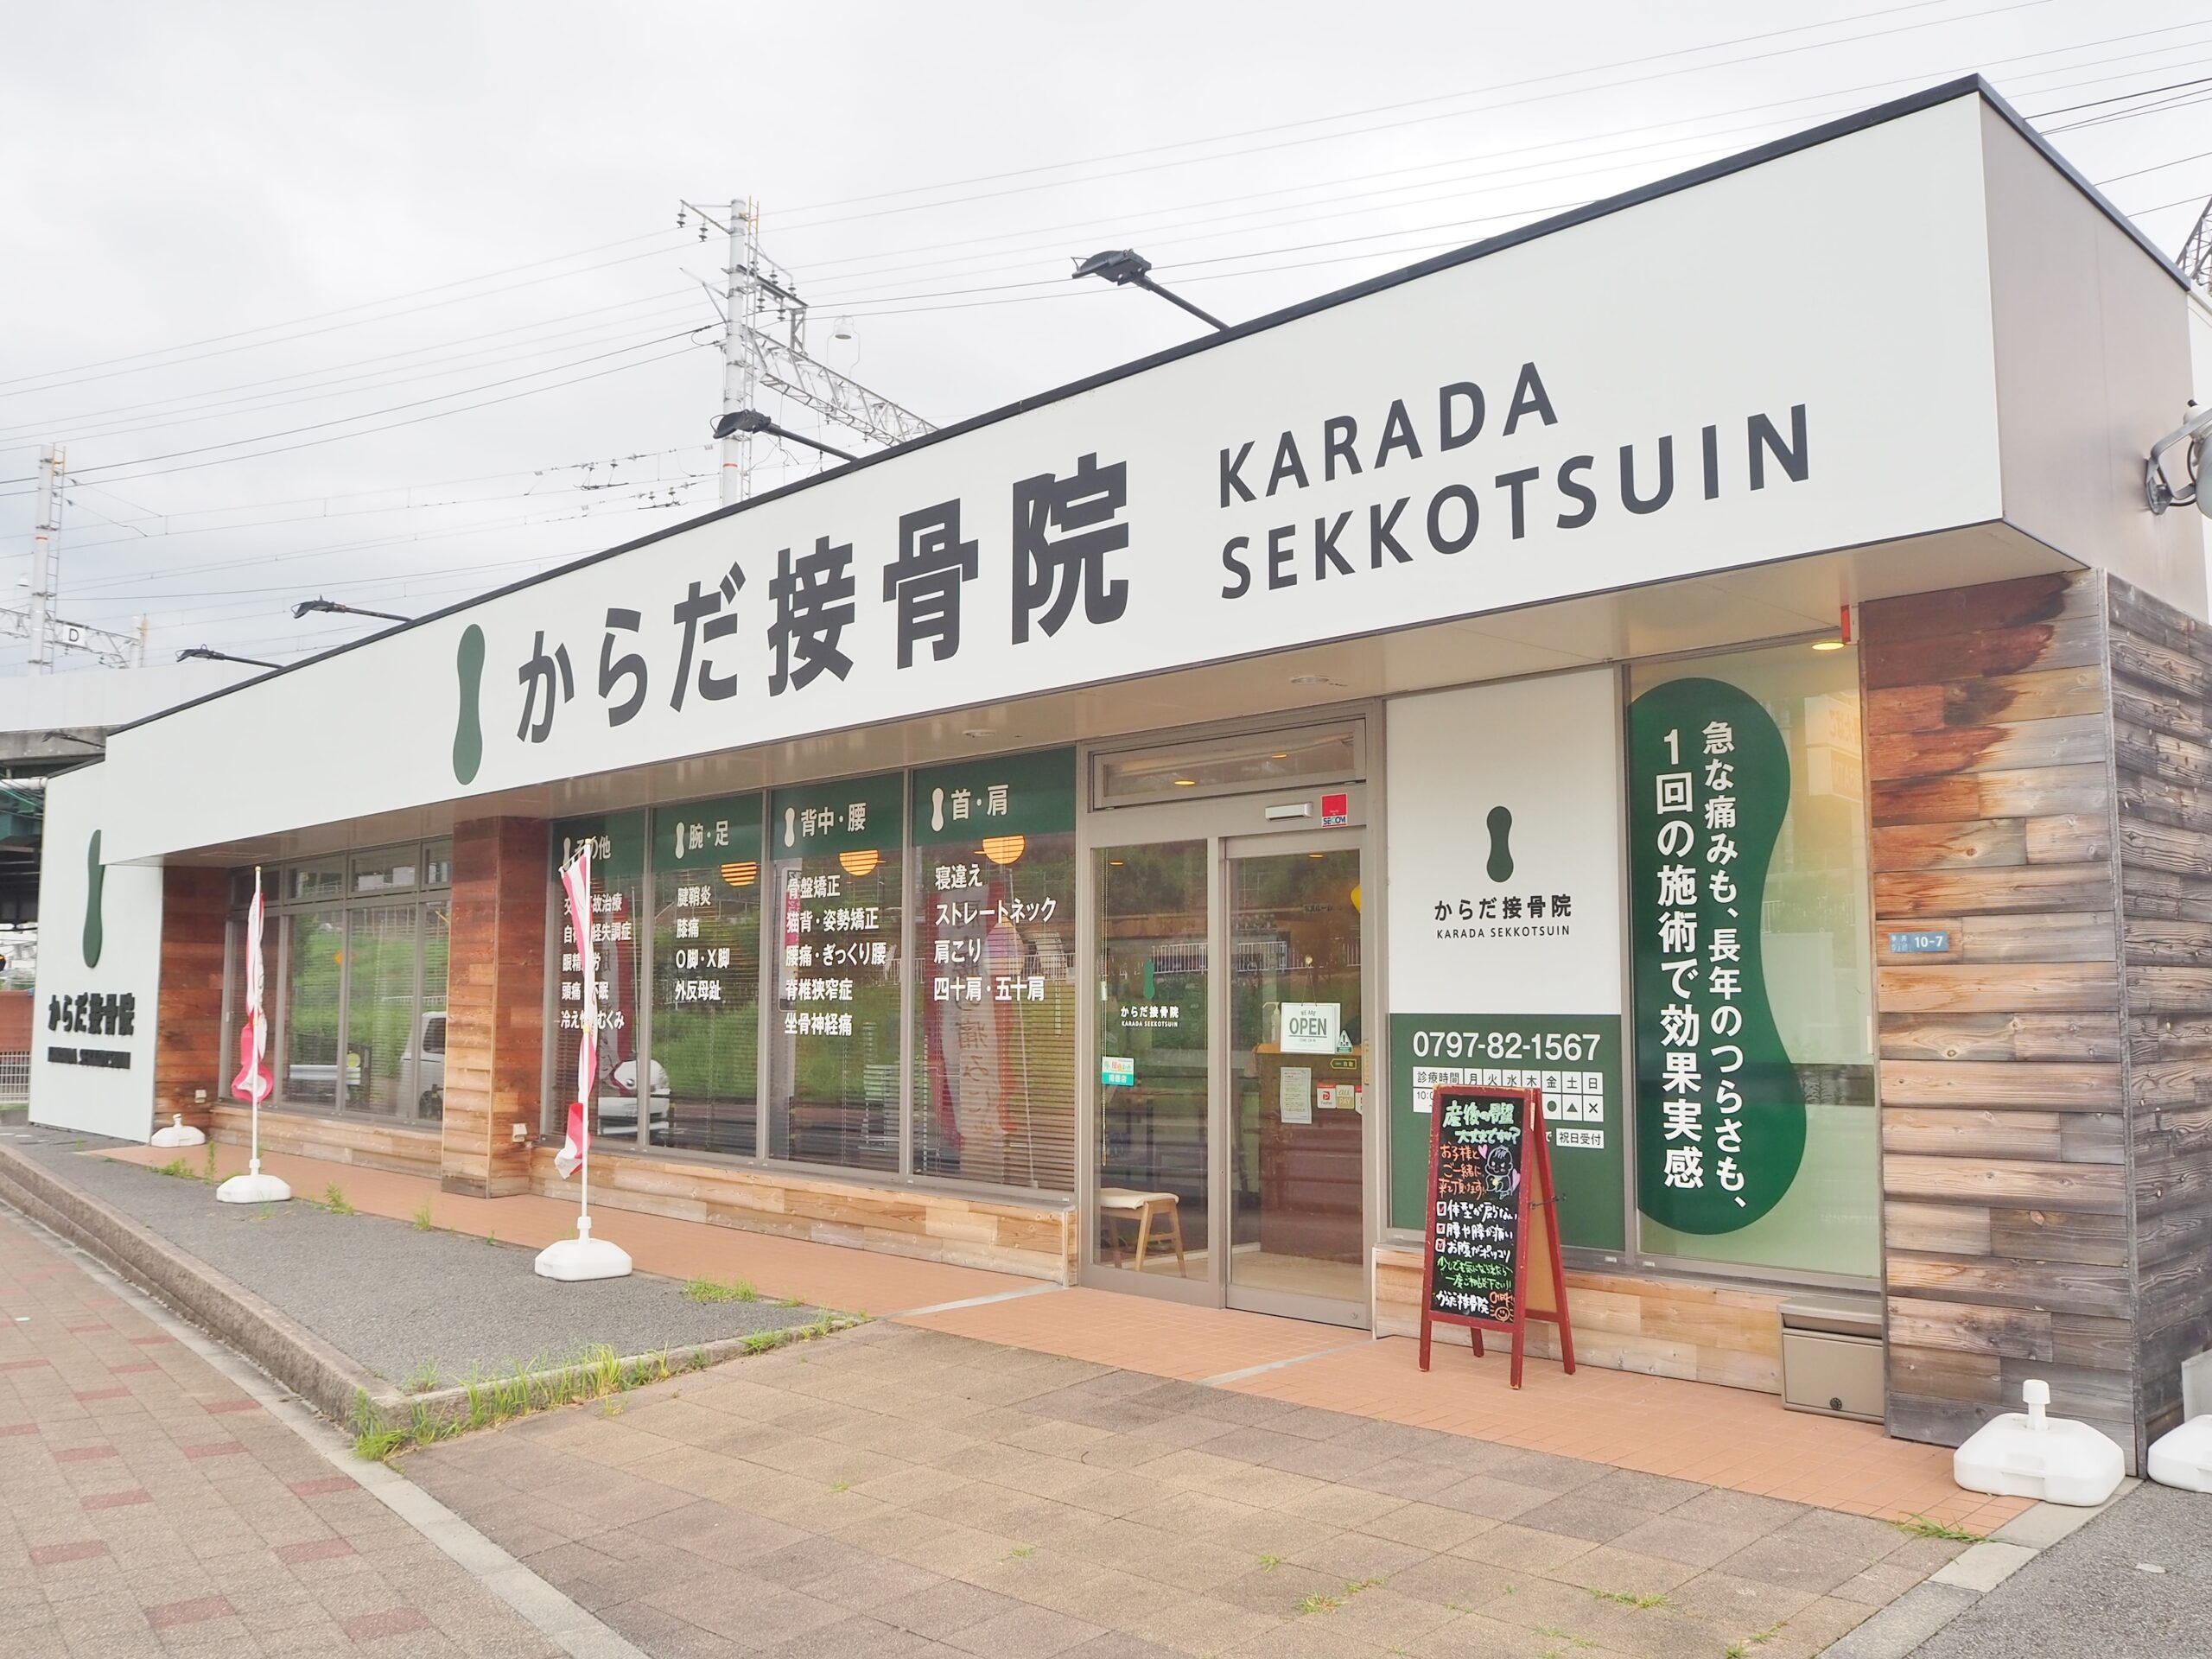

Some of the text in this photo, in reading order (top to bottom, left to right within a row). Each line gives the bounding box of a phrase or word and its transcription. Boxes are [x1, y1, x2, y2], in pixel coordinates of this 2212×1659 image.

[1219, 361, 1559, 509] KARADA
[1221, 403, 1809, 600] SEKKOTSUIN
[516, 451, 1130, 744] からだ接骨院
[69, 628, 79, 642] D
[951, 784, 1009, 820] 首・肩
[801, 802, 867, 837] 背中・腰
[1323, 816, 1346, 825] SECOM
[689, 819, 729, 850] 腕・足
[786, 874, 841, 900] 骨盤矯正
[934, 863, 983, 890] 寝違え
[677, 885, 712, 907] 腱鞘炎
[1434, 893, 1572, 922] からだ接骨院
[785, 907, 880, 934] 猫背・姿勢矯正
[935, 896, 1058, 926] ストレートネック
[676, 918, 700, 939] 膝痛
[1437, 925, 1570, 939] KARADA SEKKOTSUIN
[785, 941, 887, 968] 腰痛・ぎっくり腰
[933, 938, 982, 964] 肩こり
[1914, 936, 1943, 948] 10-7
[675, 947, 730, 969] O脚・X脚
[1656, 728, 1705, 1190] 1回の施術で効果実感
[1701, 721, 1748, 1209] 急な痛みも、長年のつらさも、
[674, 979, 721, 1001] 外反母趾
[785, 977, 854, 1002] 脊椎狭窄症
[933, 975, 1046, 1003] 四十肩・五十肩
[785, 1012, 853, 1037] 坐骨神経痛
[1120, 1005, 1179, 1019] からだ接骨院
[1289, 1018, 1327, 1036] OPEN
[1413, 1031, 1601, 1061] 0797-82-1567
[1417, 1072, 1598, 1090] 診療時間 月 火 水 木 金 土 日
[1559, 1131, 1602, 1145] 祝日受付
